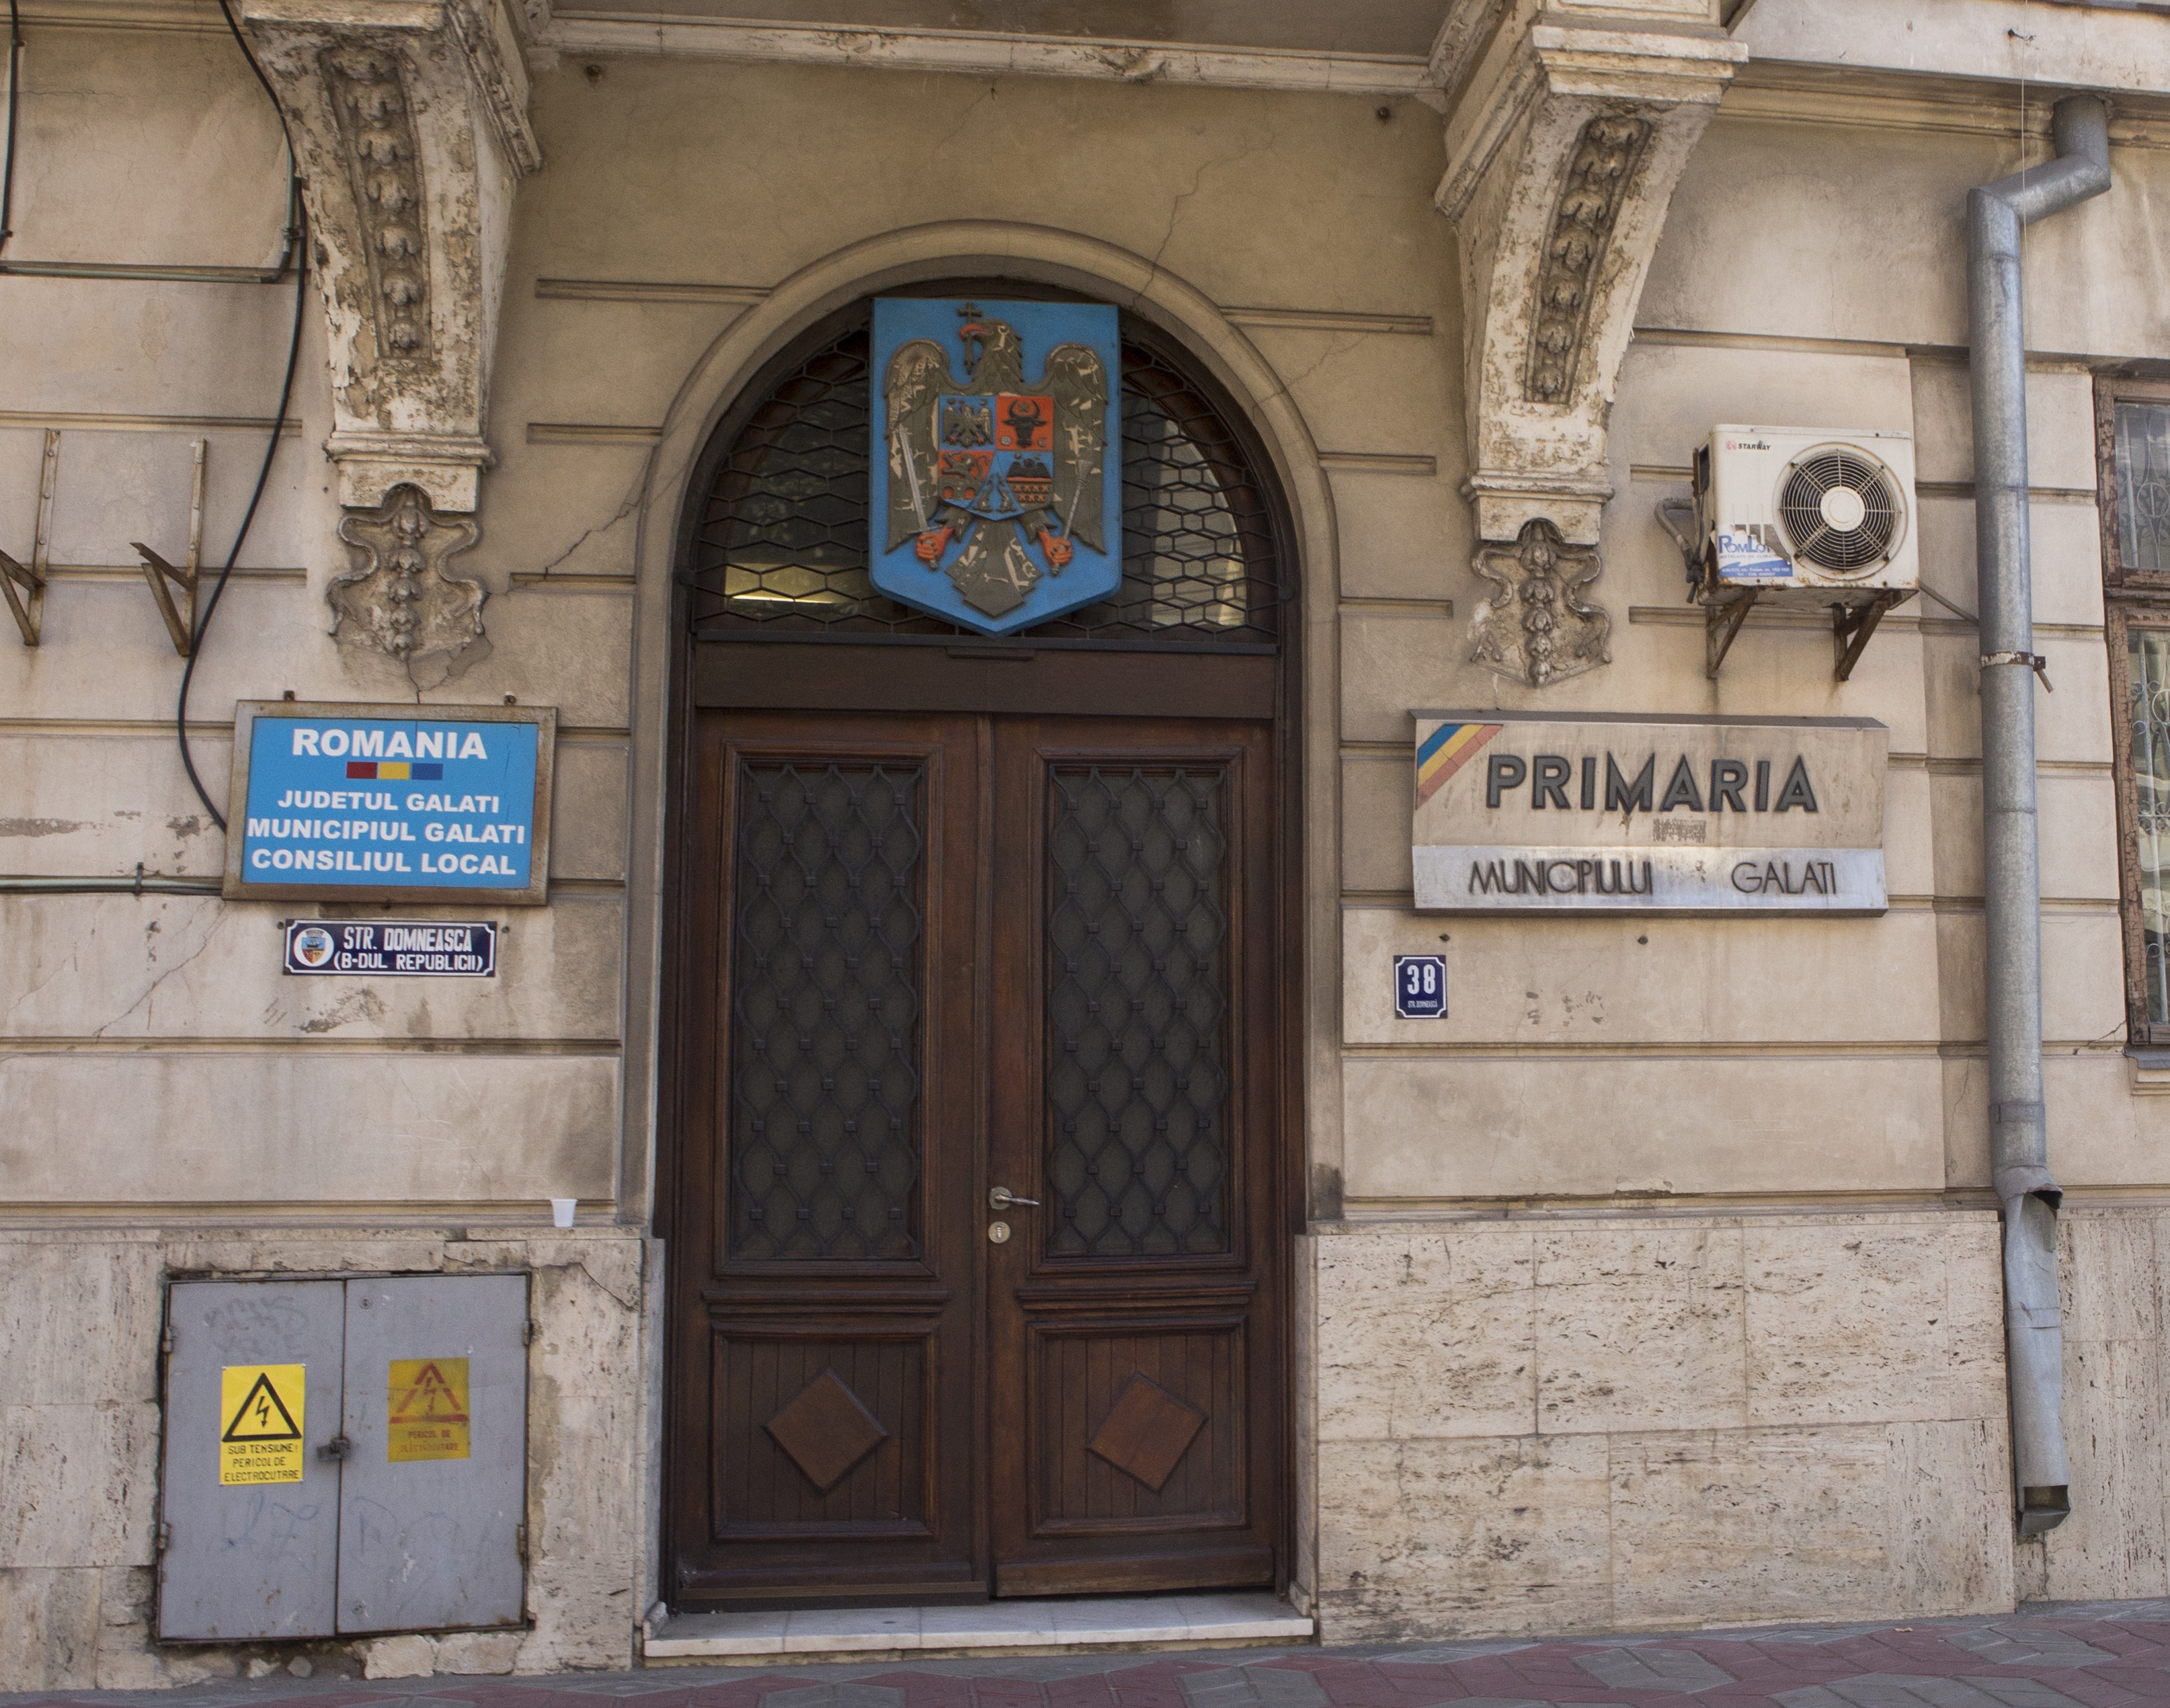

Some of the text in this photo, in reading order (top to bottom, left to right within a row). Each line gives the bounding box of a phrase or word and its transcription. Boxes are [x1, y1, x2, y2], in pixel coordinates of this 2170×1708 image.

[1738, 442, 1771, 451] STARWAY
[292, 728, 488, 760] ROMANIA
[1486, 751, 1818, 814] PRIMARIA
[278, 790, 499, 813] JUDETUL GALATI
[247, 818, 525, 844] MUNICIPIUL GALATI
[251, 850, 516, 875] CONSILIUL LOCAL
[1468, 859, 1837, 896] MUNICIPIULUI GALATI
[344, 926, 378, 950] STR.
[334, 951, 483, 972] (B-DUL REPUBLICII)
[1407, 964, 1436, 995] 38
[228, 1445, 246, 1455] SUB
[233, 1457, 286, 1468] PERICOL DE
[224, 1469, 300, 1481] ELECTROCUTARE
